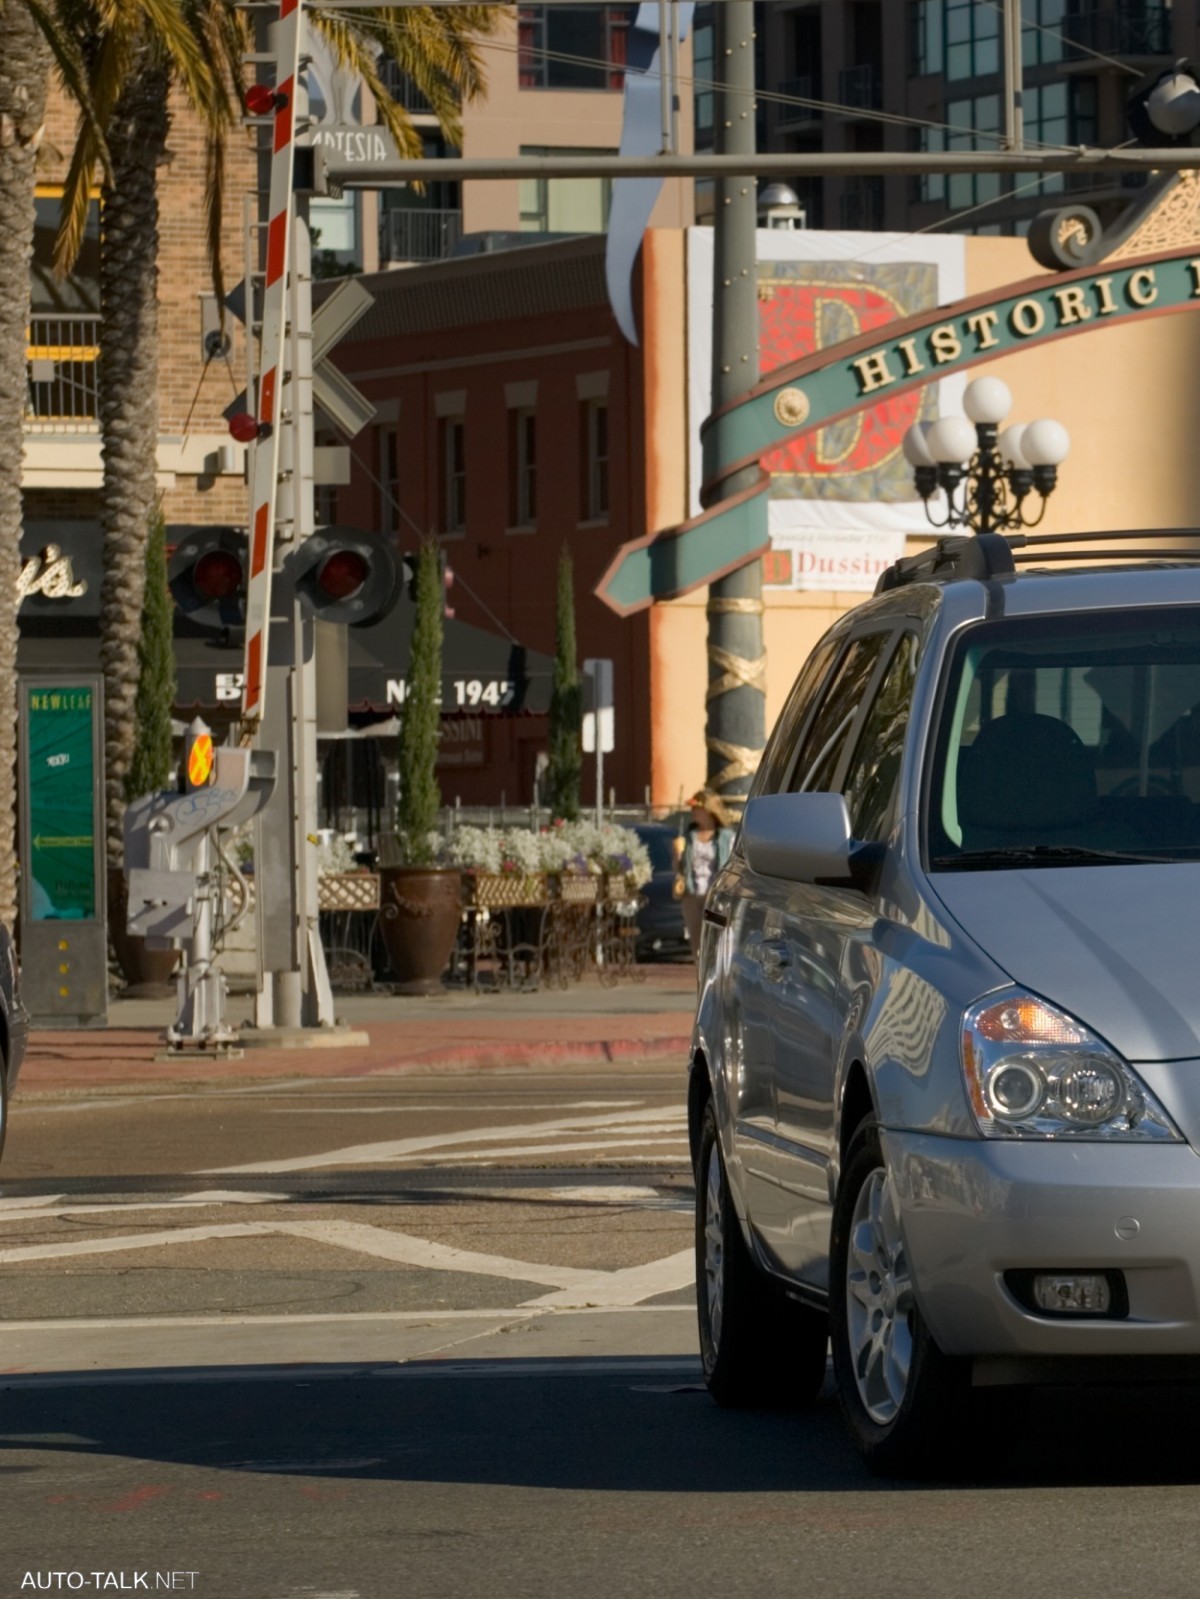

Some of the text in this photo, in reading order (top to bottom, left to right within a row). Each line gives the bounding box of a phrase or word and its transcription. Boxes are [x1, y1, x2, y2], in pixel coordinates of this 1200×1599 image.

[853, 269, 1159, 394] HISTORIC
[798, 551, 899, 575] Dussin
[454, 680, 516, 705] 1945
